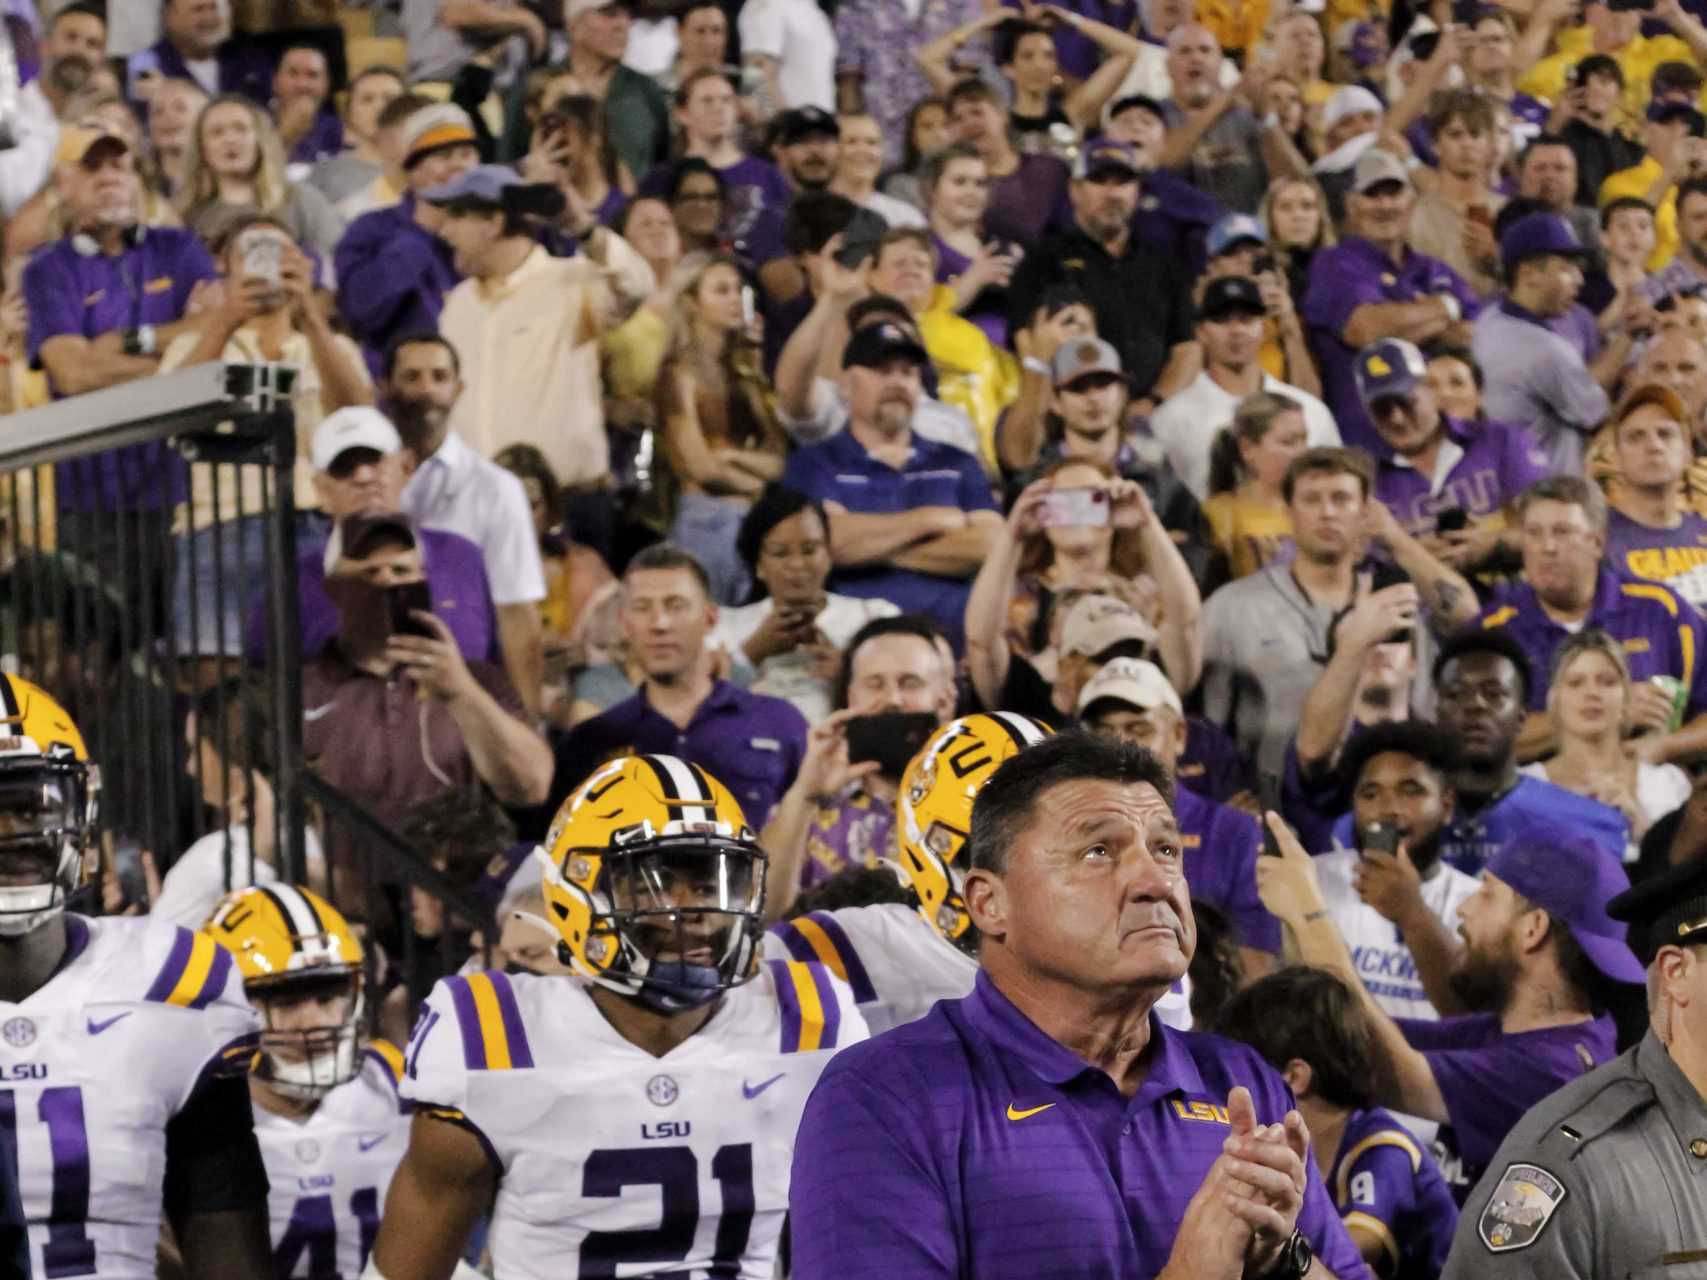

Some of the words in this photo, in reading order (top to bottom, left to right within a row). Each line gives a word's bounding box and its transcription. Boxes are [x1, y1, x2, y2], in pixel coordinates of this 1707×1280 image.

[1171, 1100, 1232, 1125] LSU
[641, 1120, 691, 1140] LSU
[298, 1174, 335, 1191] LSU
